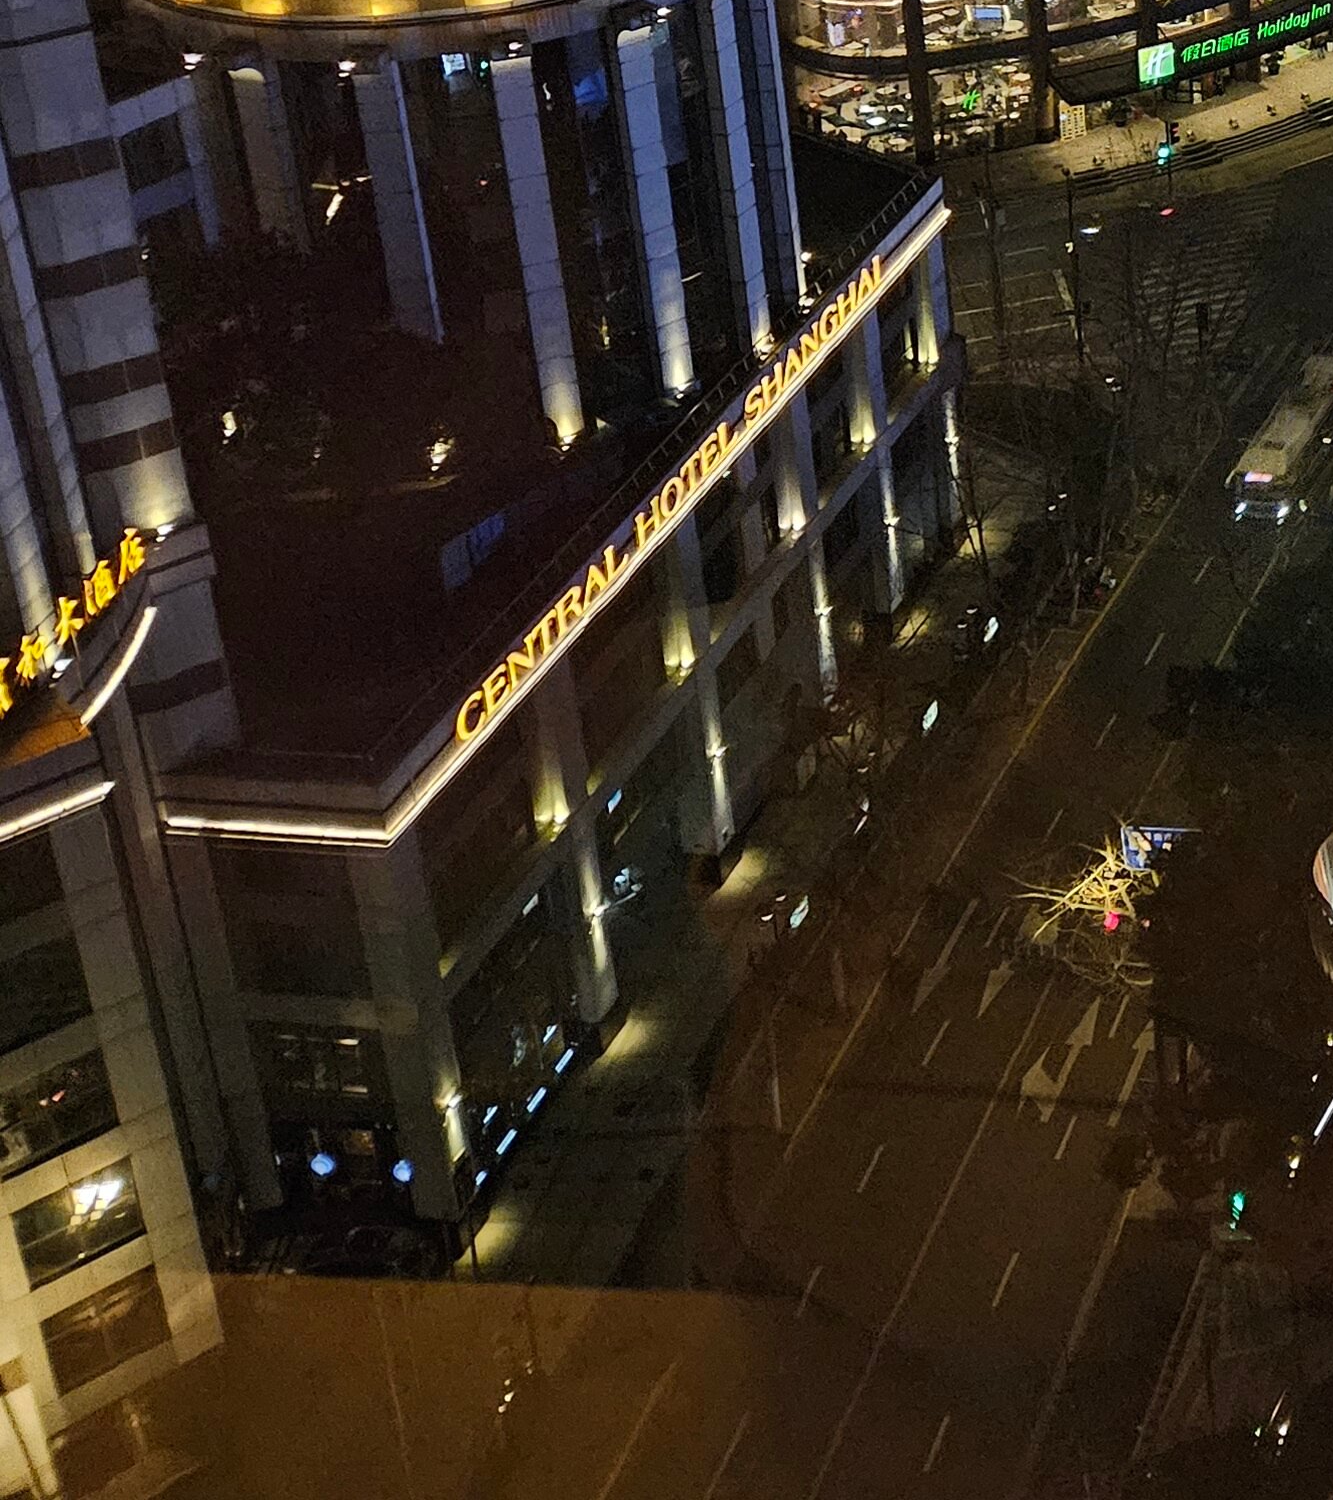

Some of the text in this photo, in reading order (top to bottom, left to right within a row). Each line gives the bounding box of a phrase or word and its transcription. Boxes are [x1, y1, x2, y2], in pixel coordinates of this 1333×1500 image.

[1256, 3, 1332, 41] Holiday Inn
[1180, 27, 1251, 64] 假日酒店
[456, 254, 883, 742] CENTRAL HOTEL SHANGHAI
